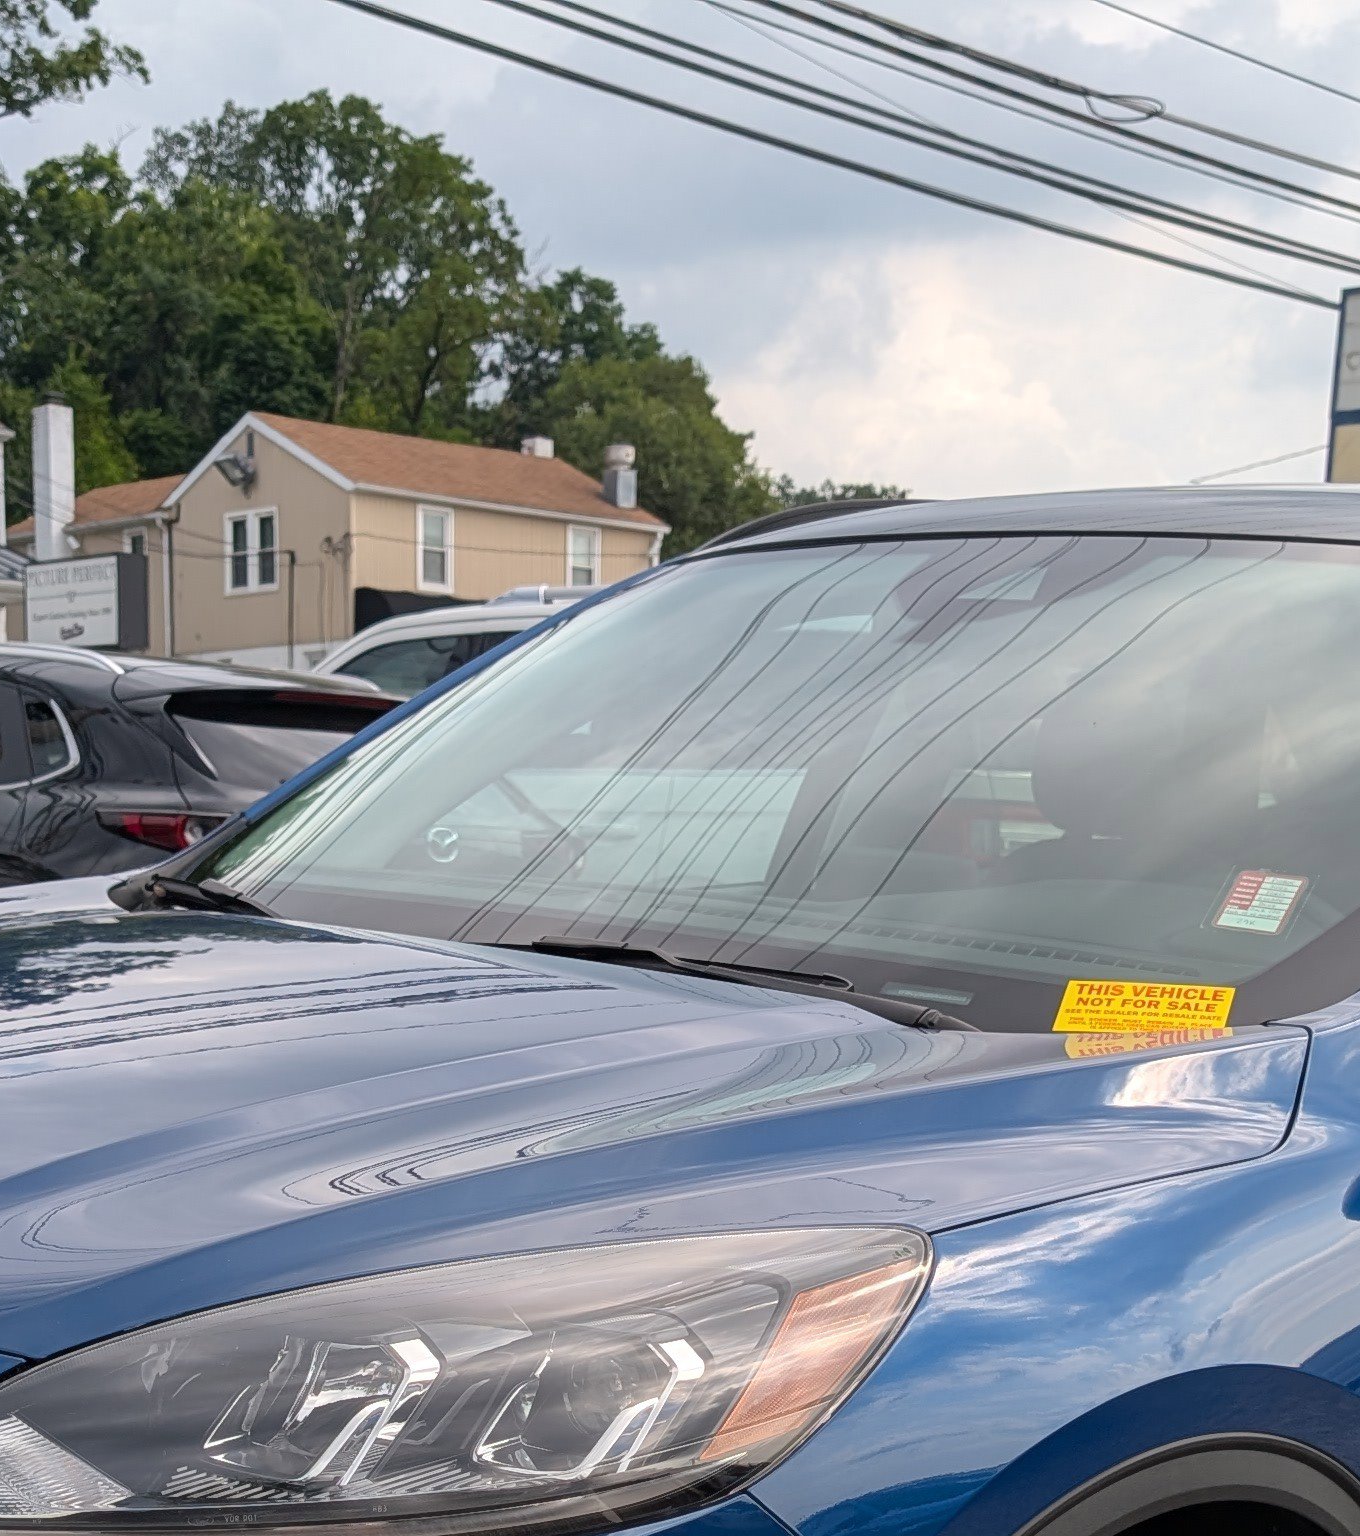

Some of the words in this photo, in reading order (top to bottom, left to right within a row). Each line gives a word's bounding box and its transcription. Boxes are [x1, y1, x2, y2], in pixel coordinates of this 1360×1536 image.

[1076, 983, 1125, 997] THIS
[1132, 985, 1227, 1002] VEHICLE
[1076, 997, 1117, 1007] NOT
[1121, 998, 1159, 1010] FOR
[1166, 1001, 1219, 1013] SALE
